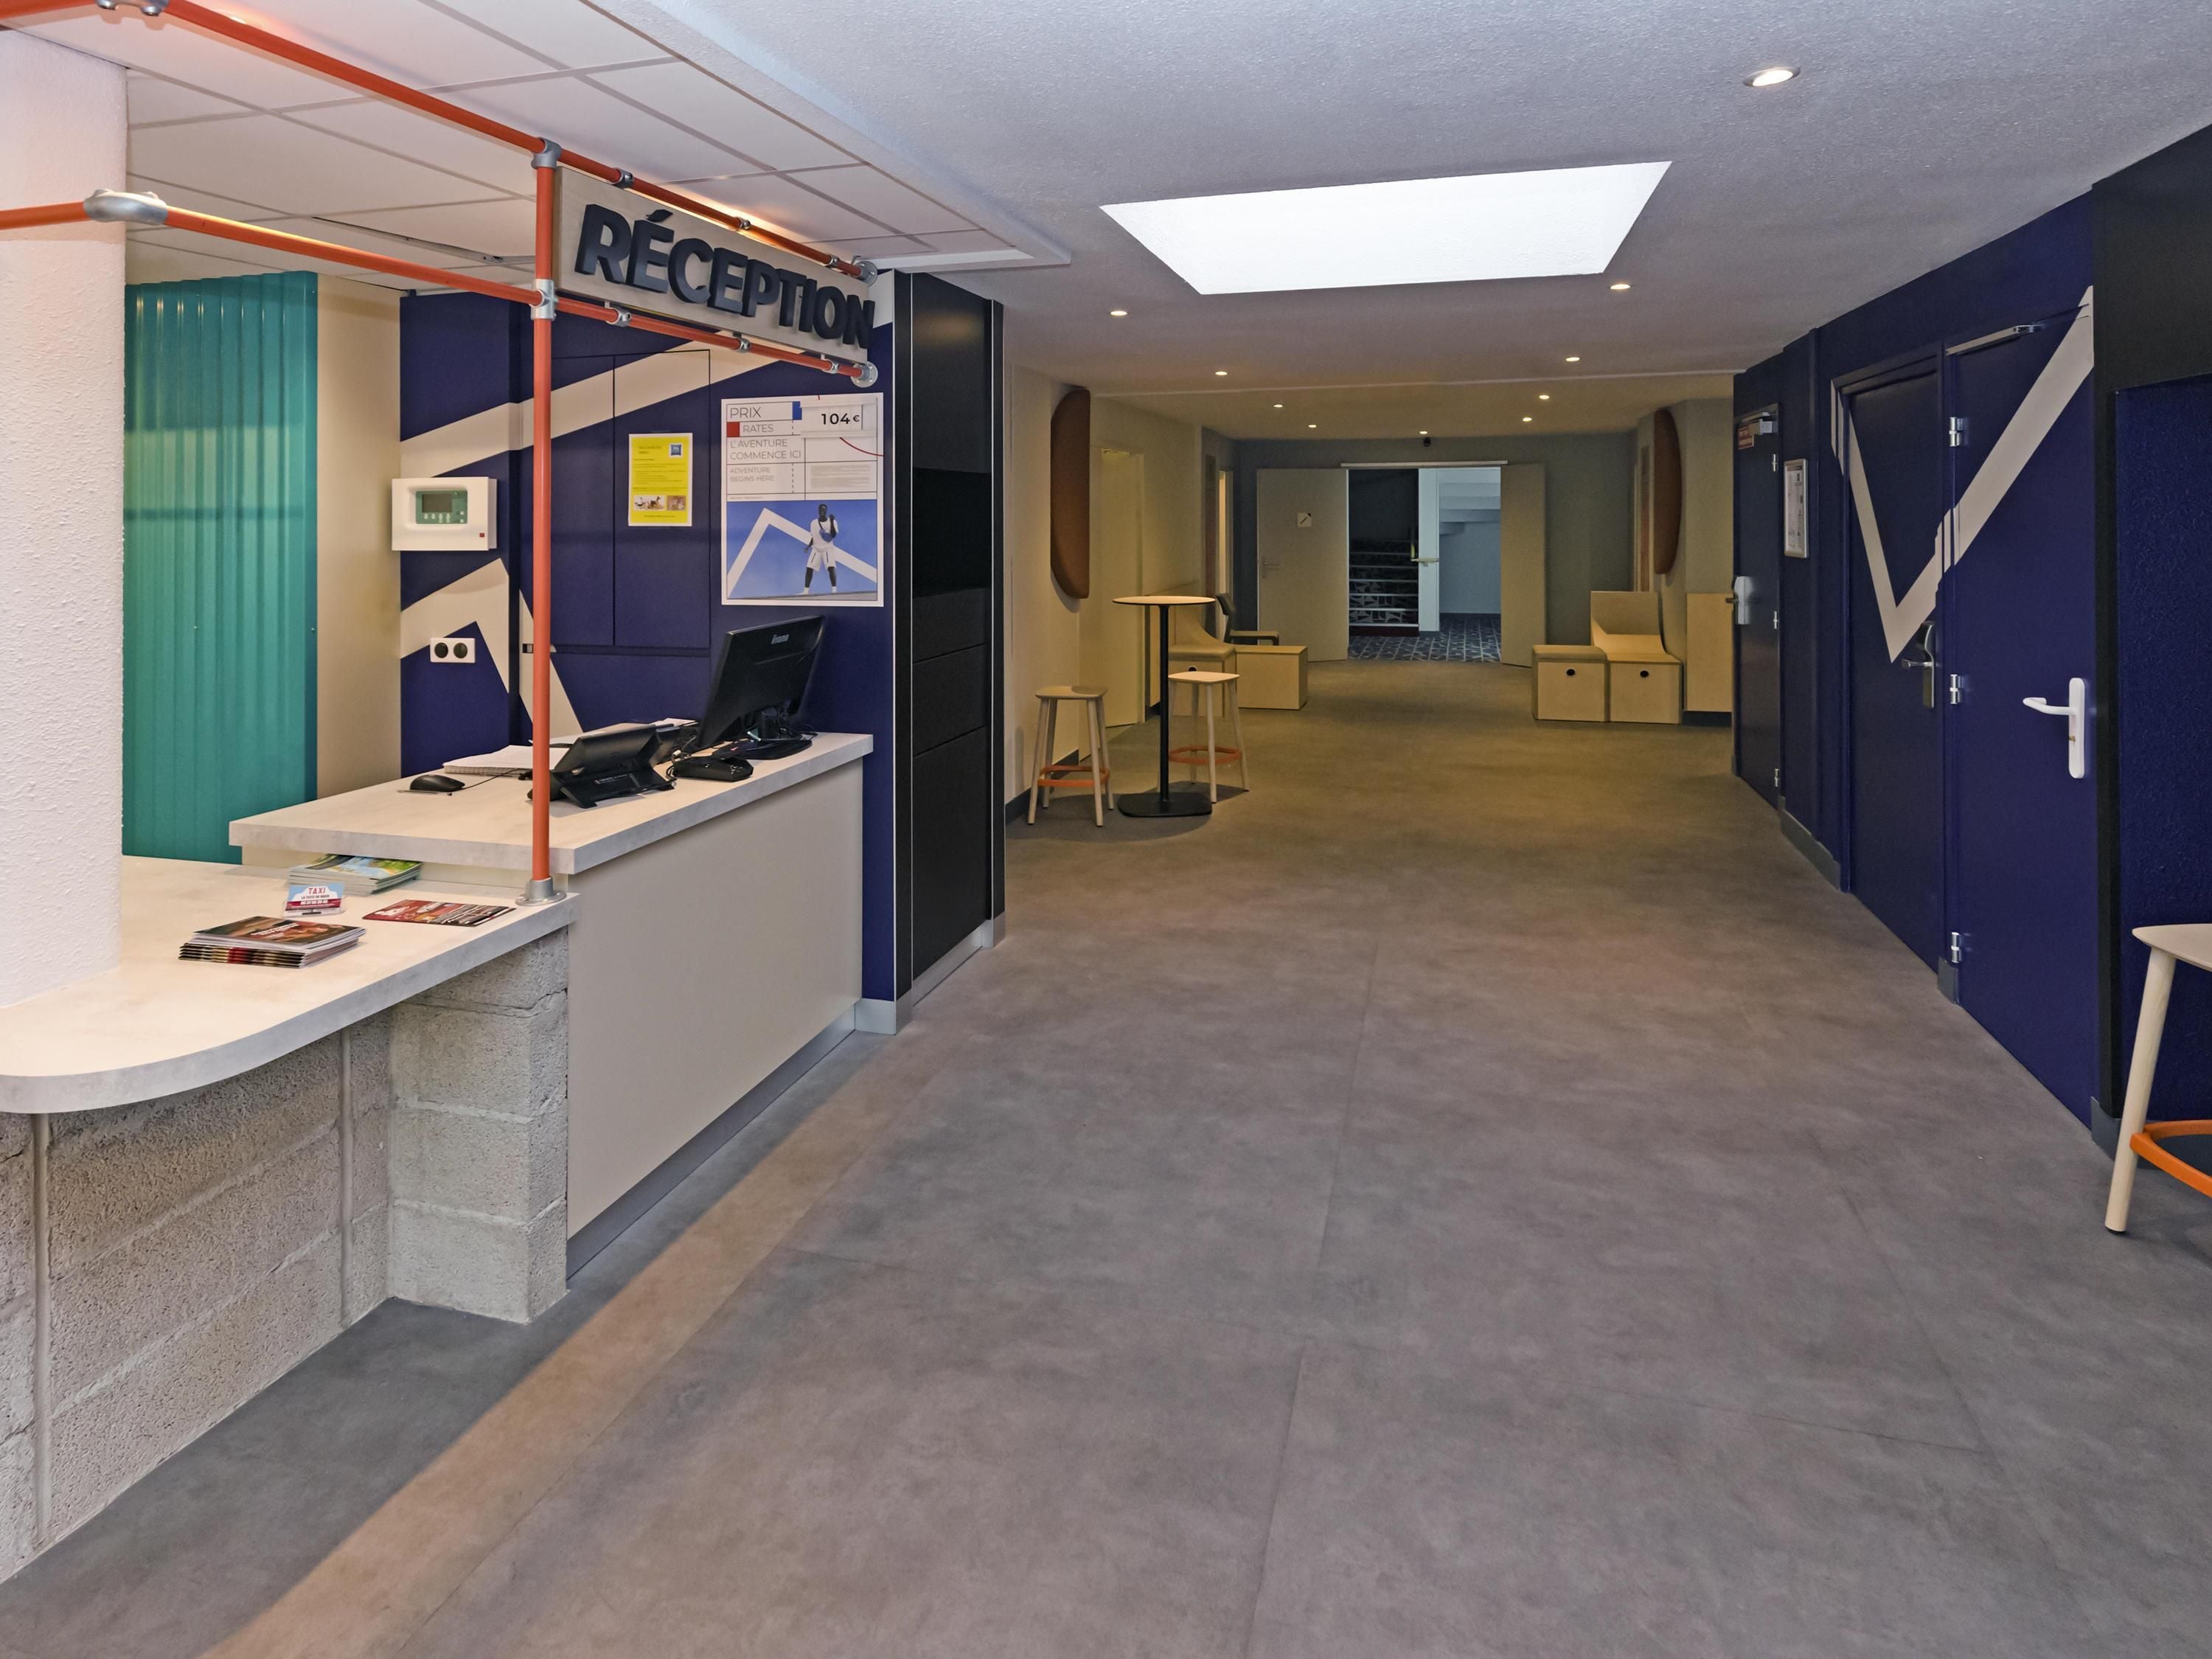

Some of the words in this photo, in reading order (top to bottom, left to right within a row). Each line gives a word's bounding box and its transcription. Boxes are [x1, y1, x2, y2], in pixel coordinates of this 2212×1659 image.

[574, 204, 875, 349] RÉCEPTION
[730, 407, 762, 419] PRIX
[742, 424, 774, 434] RATES
[729, 451, 787, 461] COMMENCE
[790, 450, 801, 459] ICI
[730, 475, 755, 483] BEGINS
[757, 474, 775, 482] HERE
[308, 887, 326, 895] TAXI
